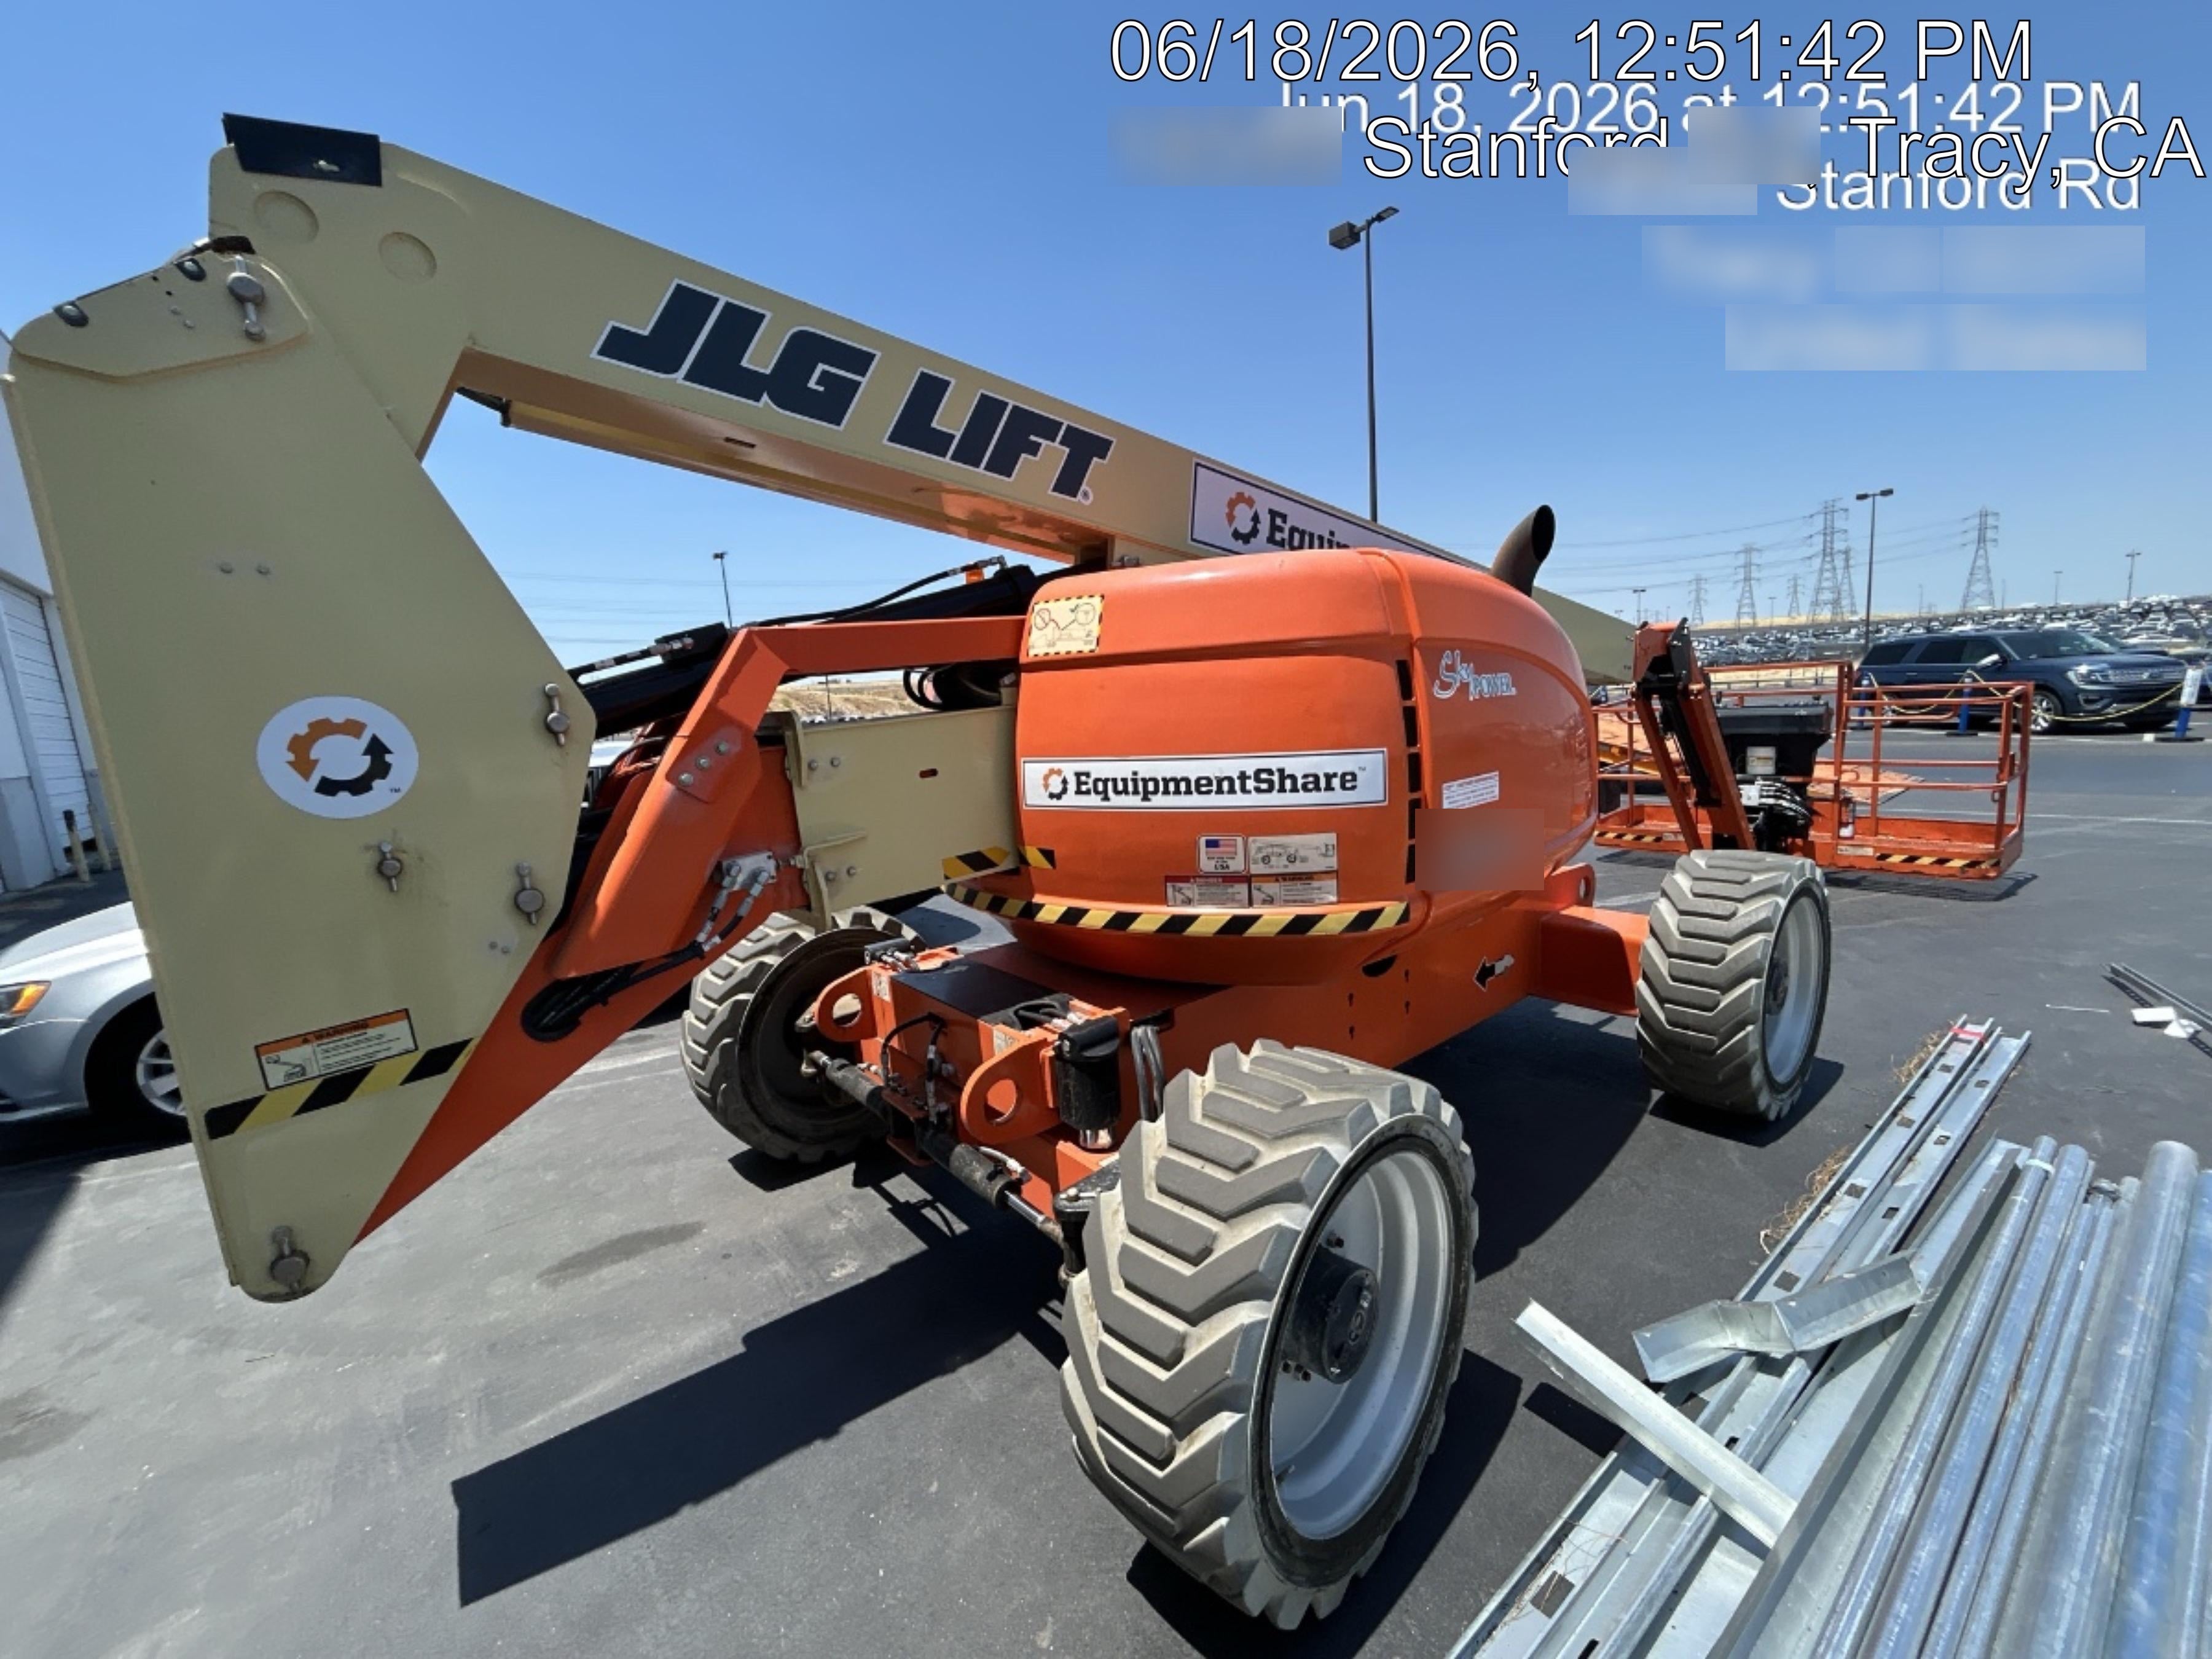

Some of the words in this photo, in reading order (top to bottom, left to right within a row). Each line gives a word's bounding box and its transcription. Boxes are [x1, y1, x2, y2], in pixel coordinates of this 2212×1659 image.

[590, 278, 881, 430] JLG
[883, 368, 1115, 500] LIFT
[1073, 767, 1358, 802] EquipmentShare
